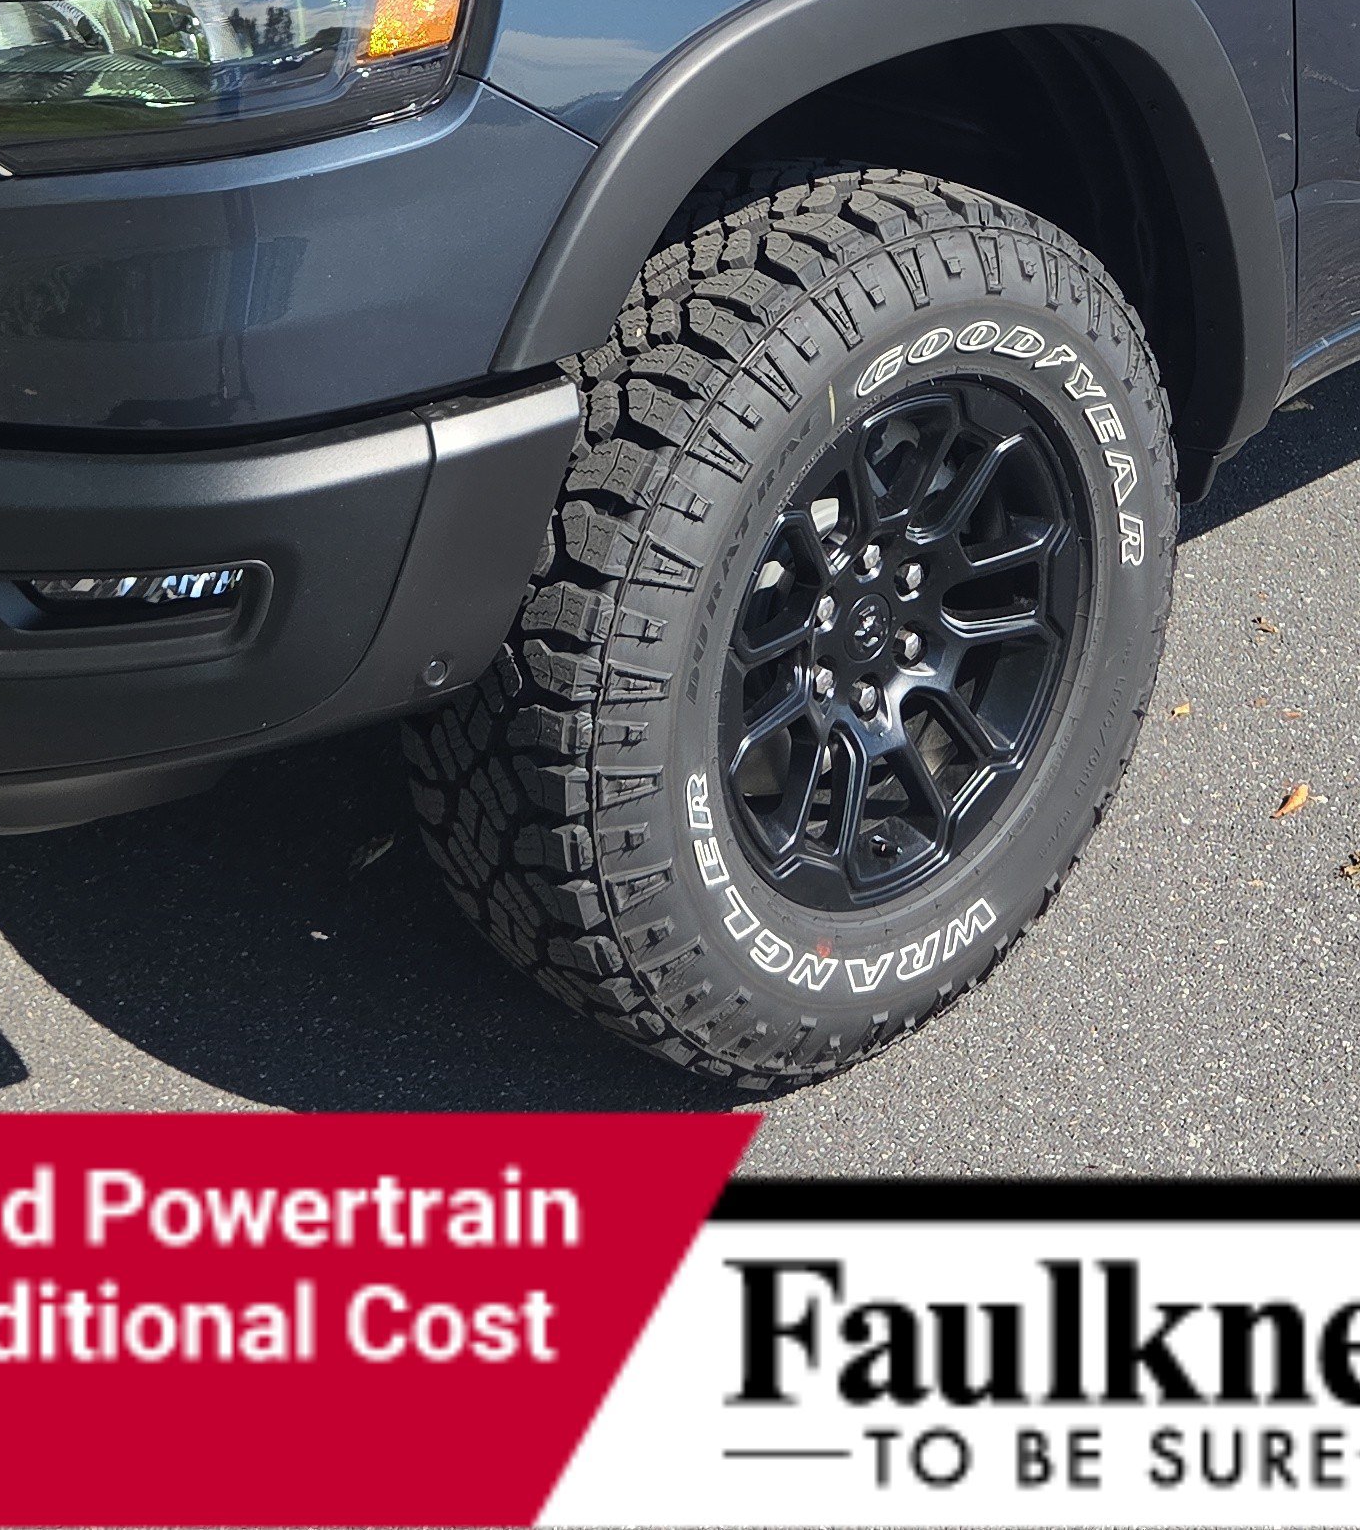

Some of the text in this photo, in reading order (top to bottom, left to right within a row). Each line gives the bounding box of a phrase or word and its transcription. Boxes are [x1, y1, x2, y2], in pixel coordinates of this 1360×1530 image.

[686, 406, 821, 705] DURATRAC
[857, 320, 1146, 568] GOODYEAR
[686, 774, 995, 994] WRANGLER
